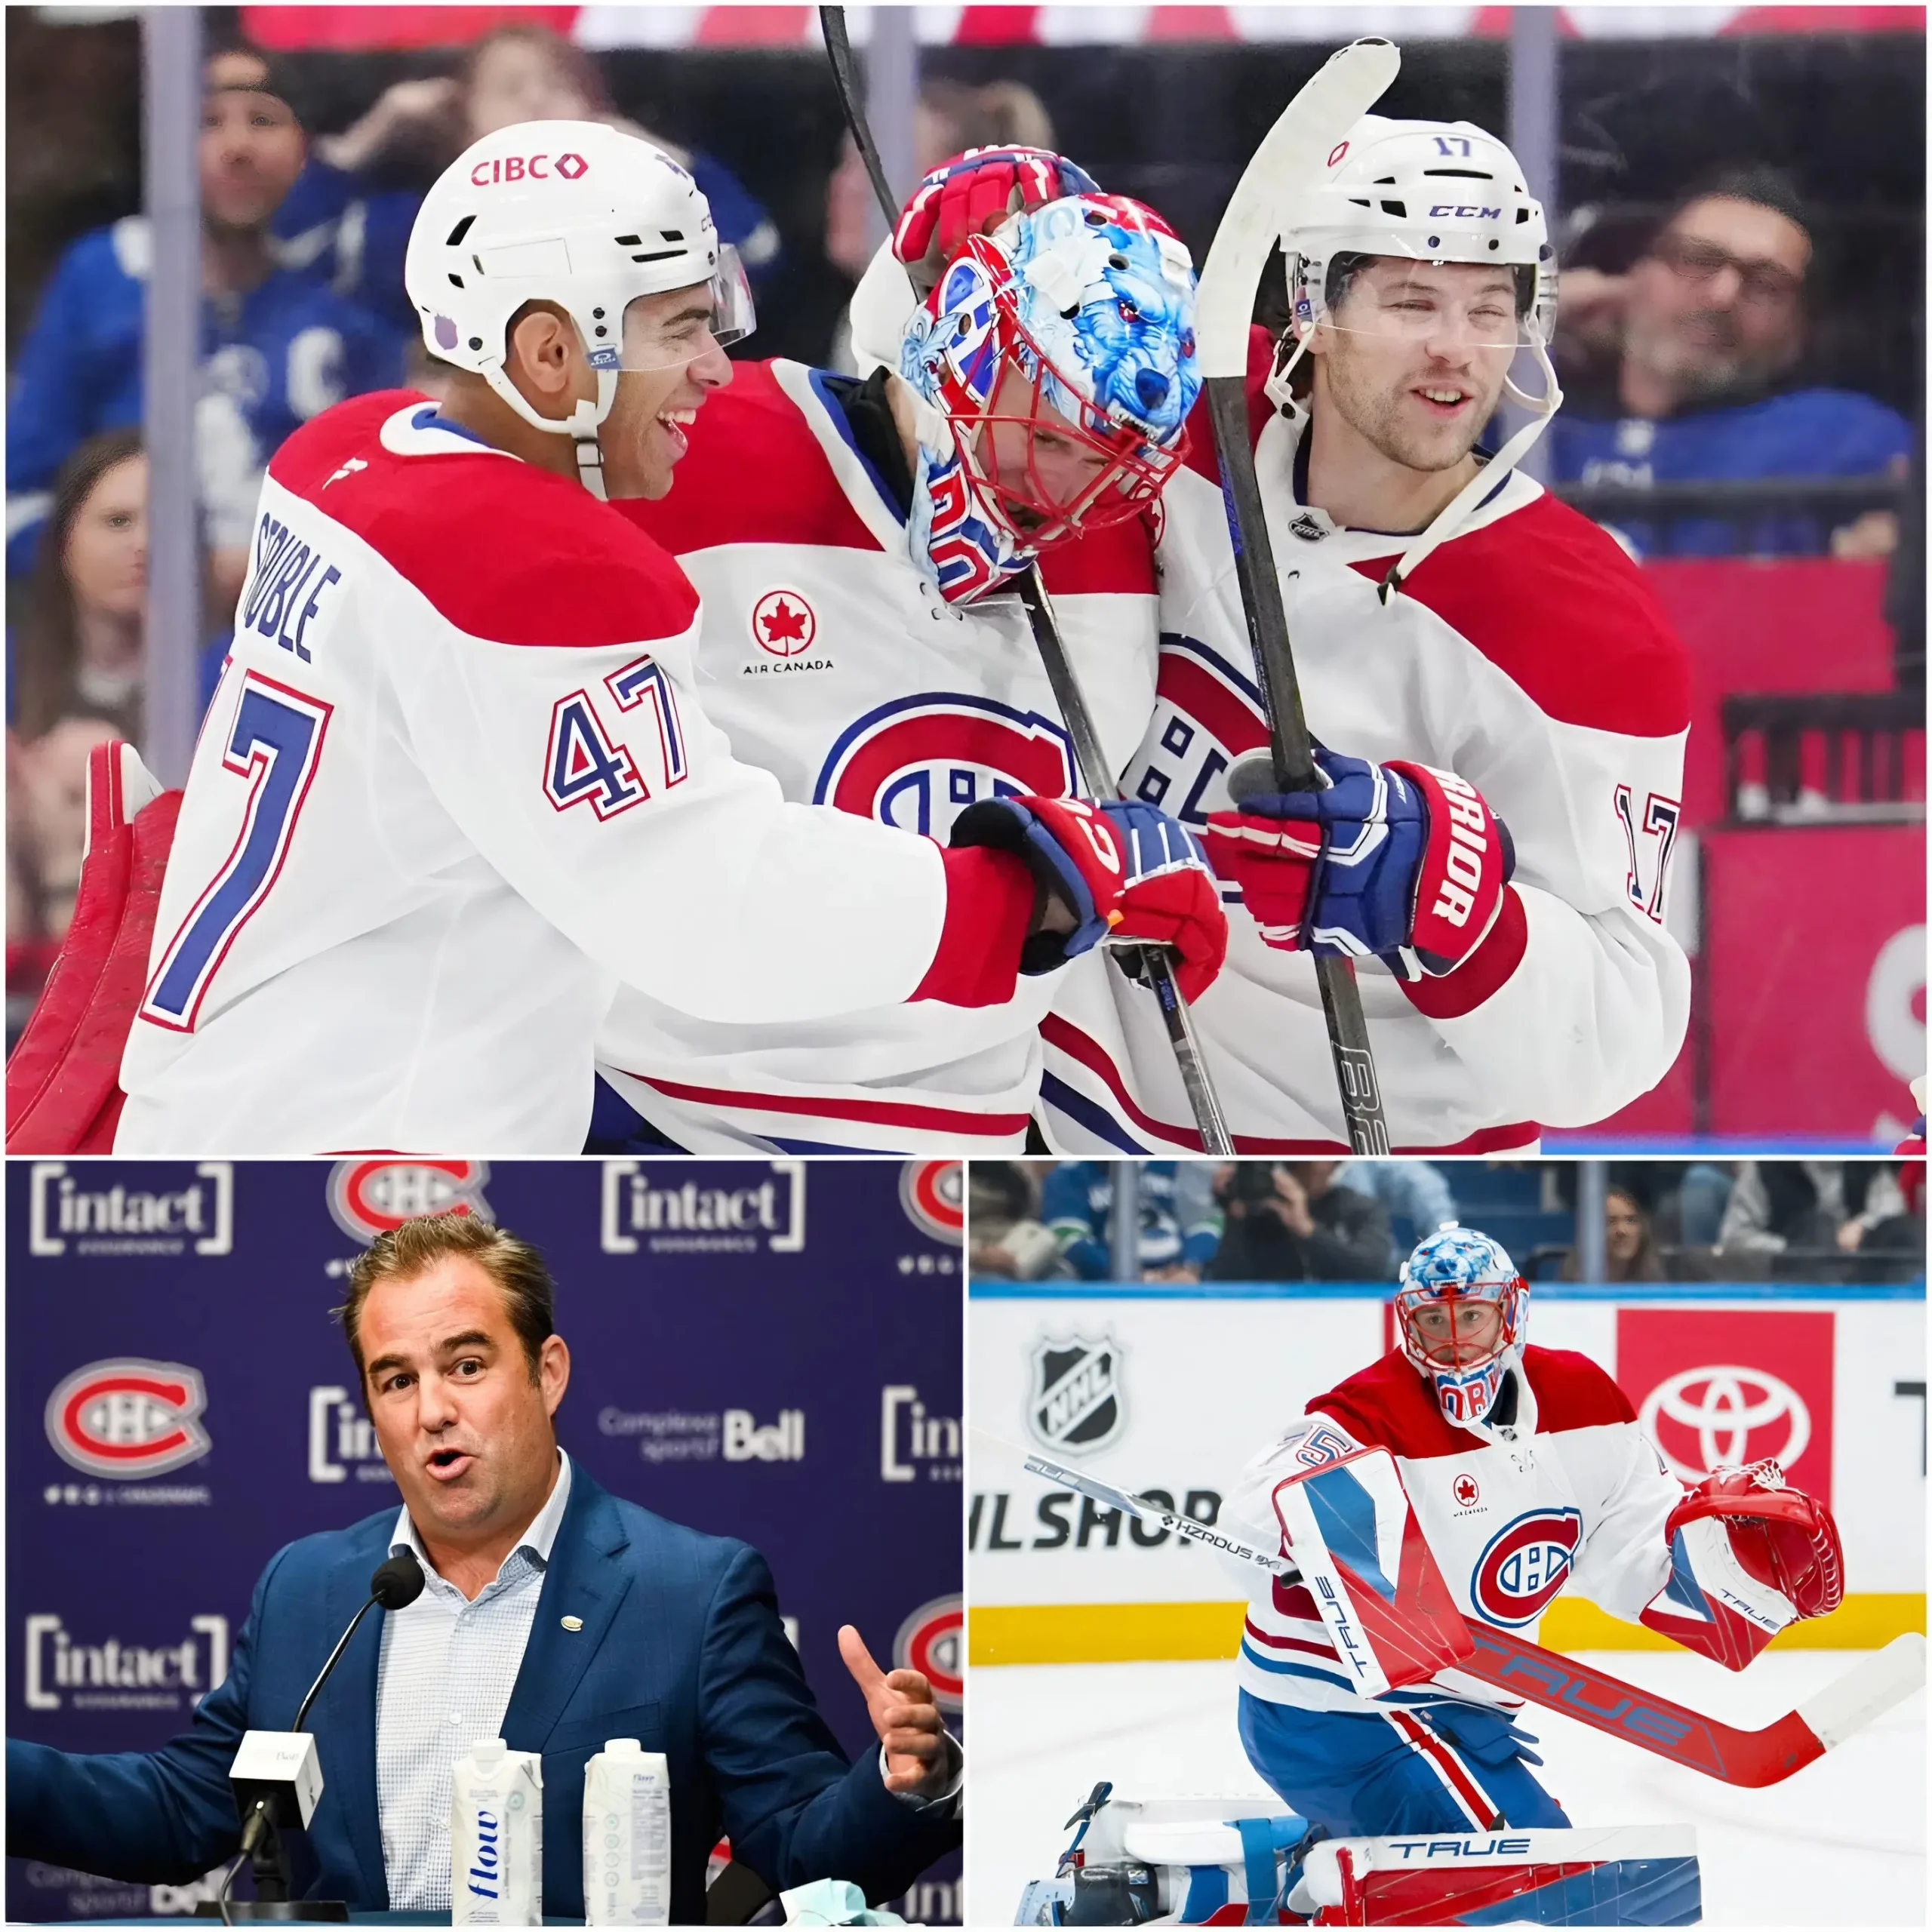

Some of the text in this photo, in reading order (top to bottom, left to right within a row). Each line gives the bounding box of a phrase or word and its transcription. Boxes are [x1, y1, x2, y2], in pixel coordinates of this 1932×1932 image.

[471, 155, 549, 186] CIBC
[1433, 137, 1471, 157] 17
[1429, 205, 1502, 219] CCM
[743, 660, 835, 675] AIR CANADA
[542, 654, 688, 823] 47
[138, 655, 334, 1034] 7
[1614, 783, 1681, 924] 17
[1045, 1360, 1111, 1438] NHL
[722, 1407, 804, 1463] Bell
[1314, 1575, 1367, 1679] TRUE
[1720, 1588, 1781, 1630] TRUE
[467, 1810, 499, 1900] flow
[1388, 1838, 1531, 1859] TRUE
